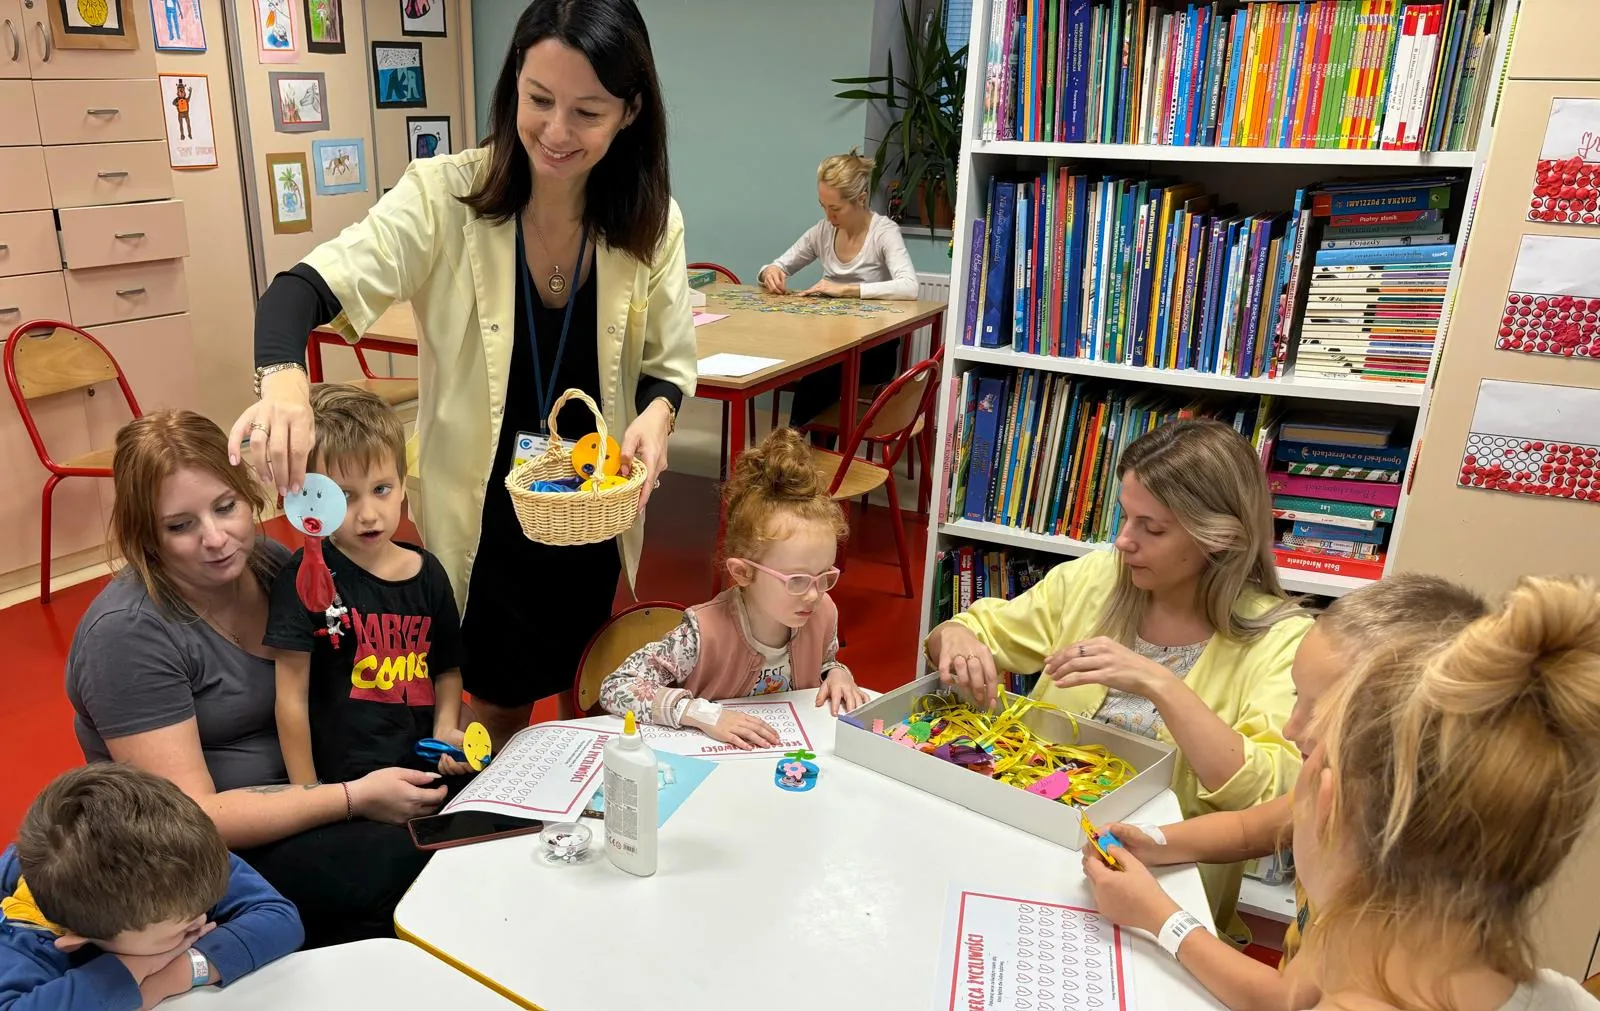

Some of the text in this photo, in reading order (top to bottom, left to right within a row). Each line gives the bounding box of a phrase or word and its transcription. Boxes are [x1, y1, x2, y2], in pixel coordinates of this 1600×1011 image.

[1346, 198, 1380, 206] PUZZLAMI
[1252, 262, 1264, 296] Narodzenie
[1320, 504, 1330, 512] Las
[1287, 558, 1340, 572] Boże Narodzenie
[965, 934, 984, 985] ŻYCZLIWOŚCI
